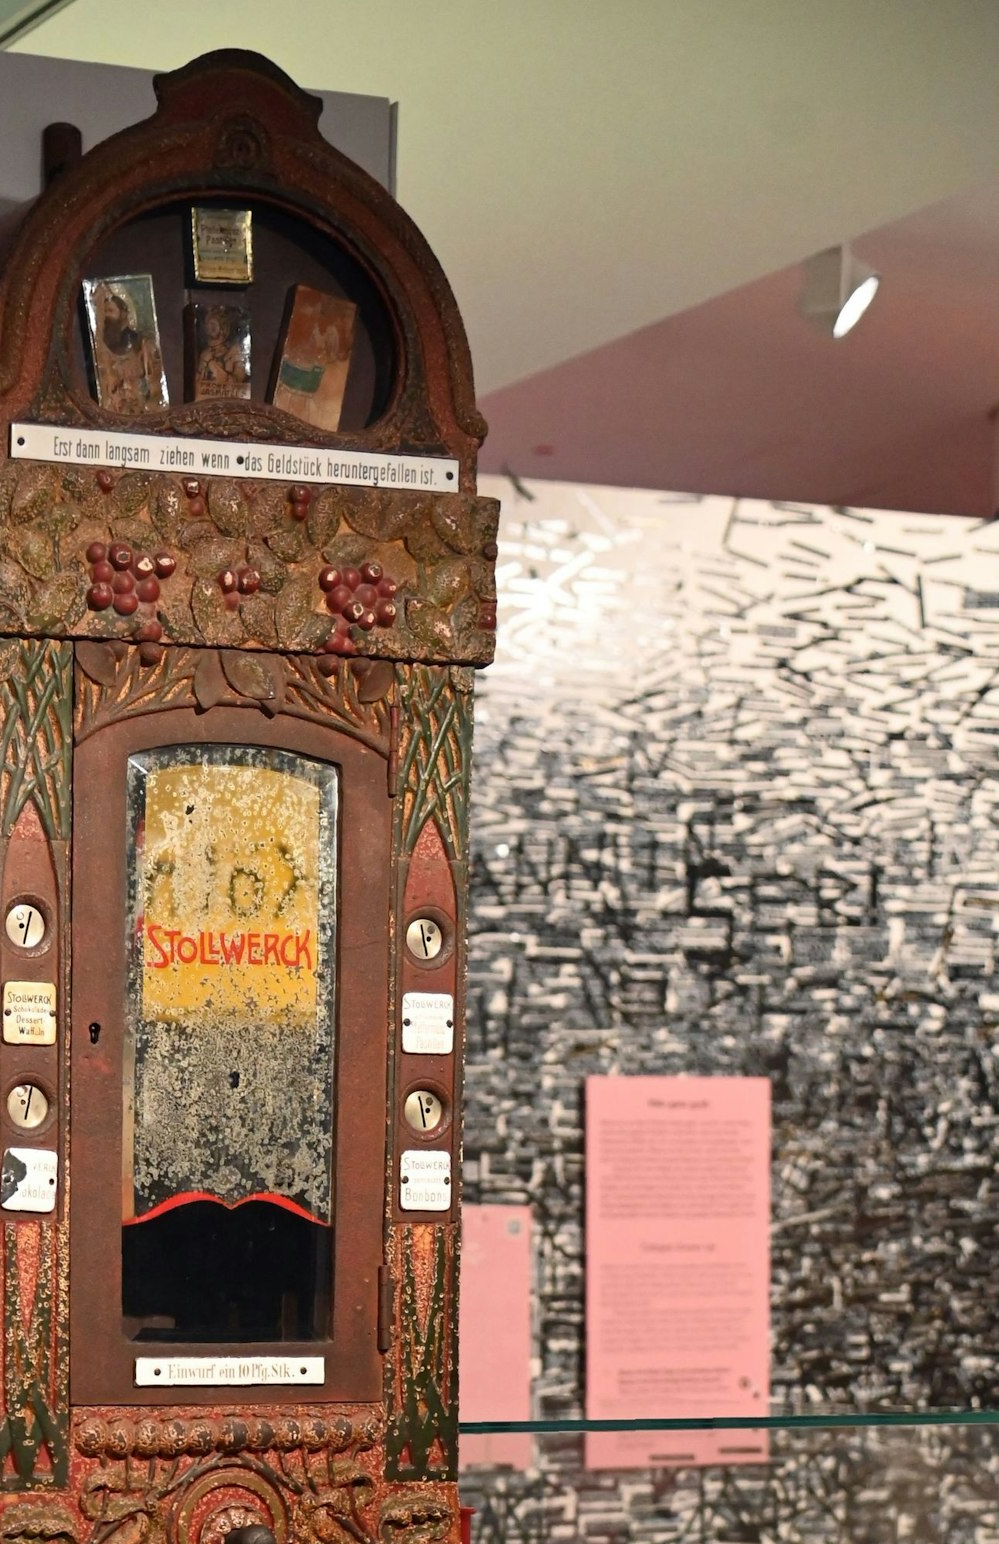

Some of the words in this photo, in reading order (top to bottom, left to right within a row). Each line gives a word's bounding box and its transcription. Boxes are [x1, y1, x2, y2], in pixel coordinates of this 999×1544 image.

[53, 436, 72, 457] Erst
[75, 439, 100, 459] dann
[105, 440, 150, 467] langsam
[160, 445, 195, 466] ziehen
[201, 452, 230, 469] wenn
[244, 451, 262, 472] das
[267, 453, 322, 477] Geldstück
[327, 457, 417, 486] heruntergefallen
[420, 464, 438, 486] ist.
[146, 925, 312, 970] STOLLWERCK
[7, 991, 52, 1005] STOLLWERCK
[168, 1364, 216, 1379] Einwurf
[219, 1365, 236, 1378] ein
